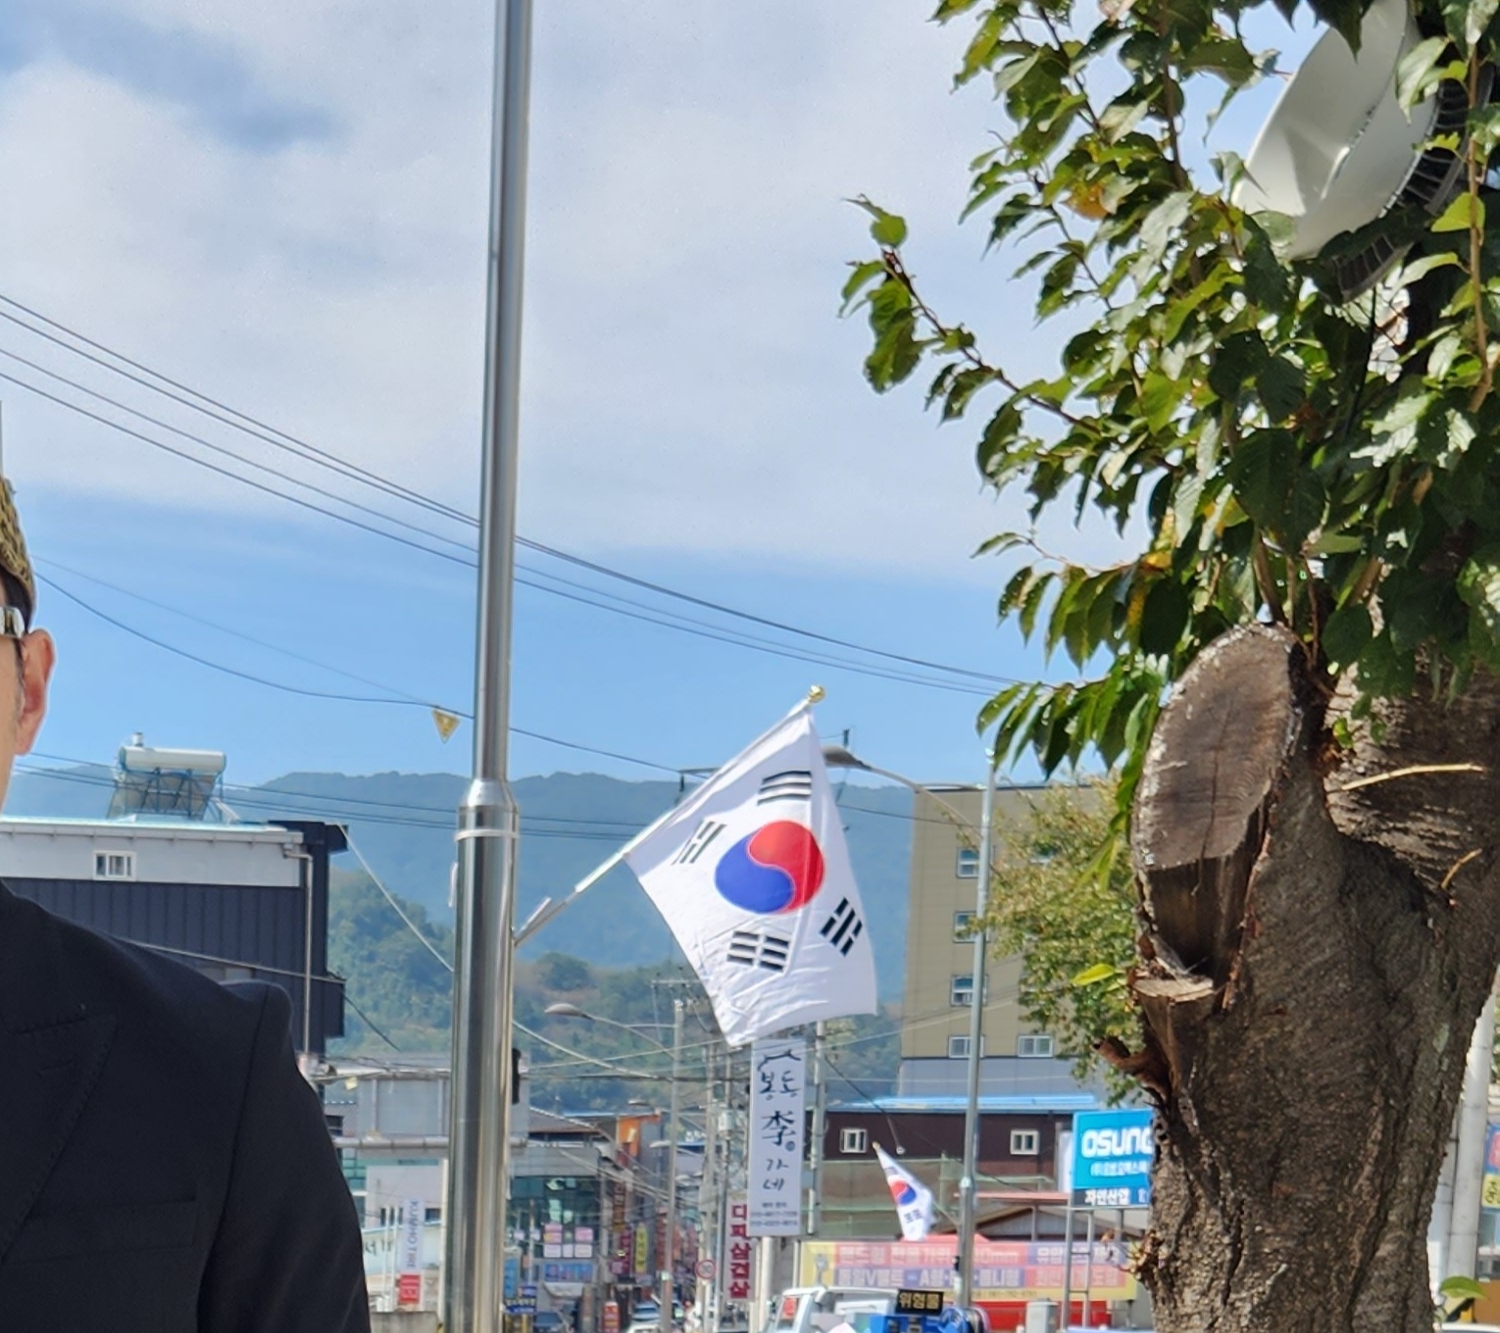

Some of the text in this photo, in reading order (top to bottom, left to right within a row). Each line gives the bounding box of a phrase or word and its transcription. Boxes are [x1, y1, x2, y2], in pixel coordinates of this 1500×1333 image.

[406, 1201, 420, 1244] KUMHO
[406, 1247, 419, 1268] TIRE
[899, 1292, 940, 1309] 위험물
